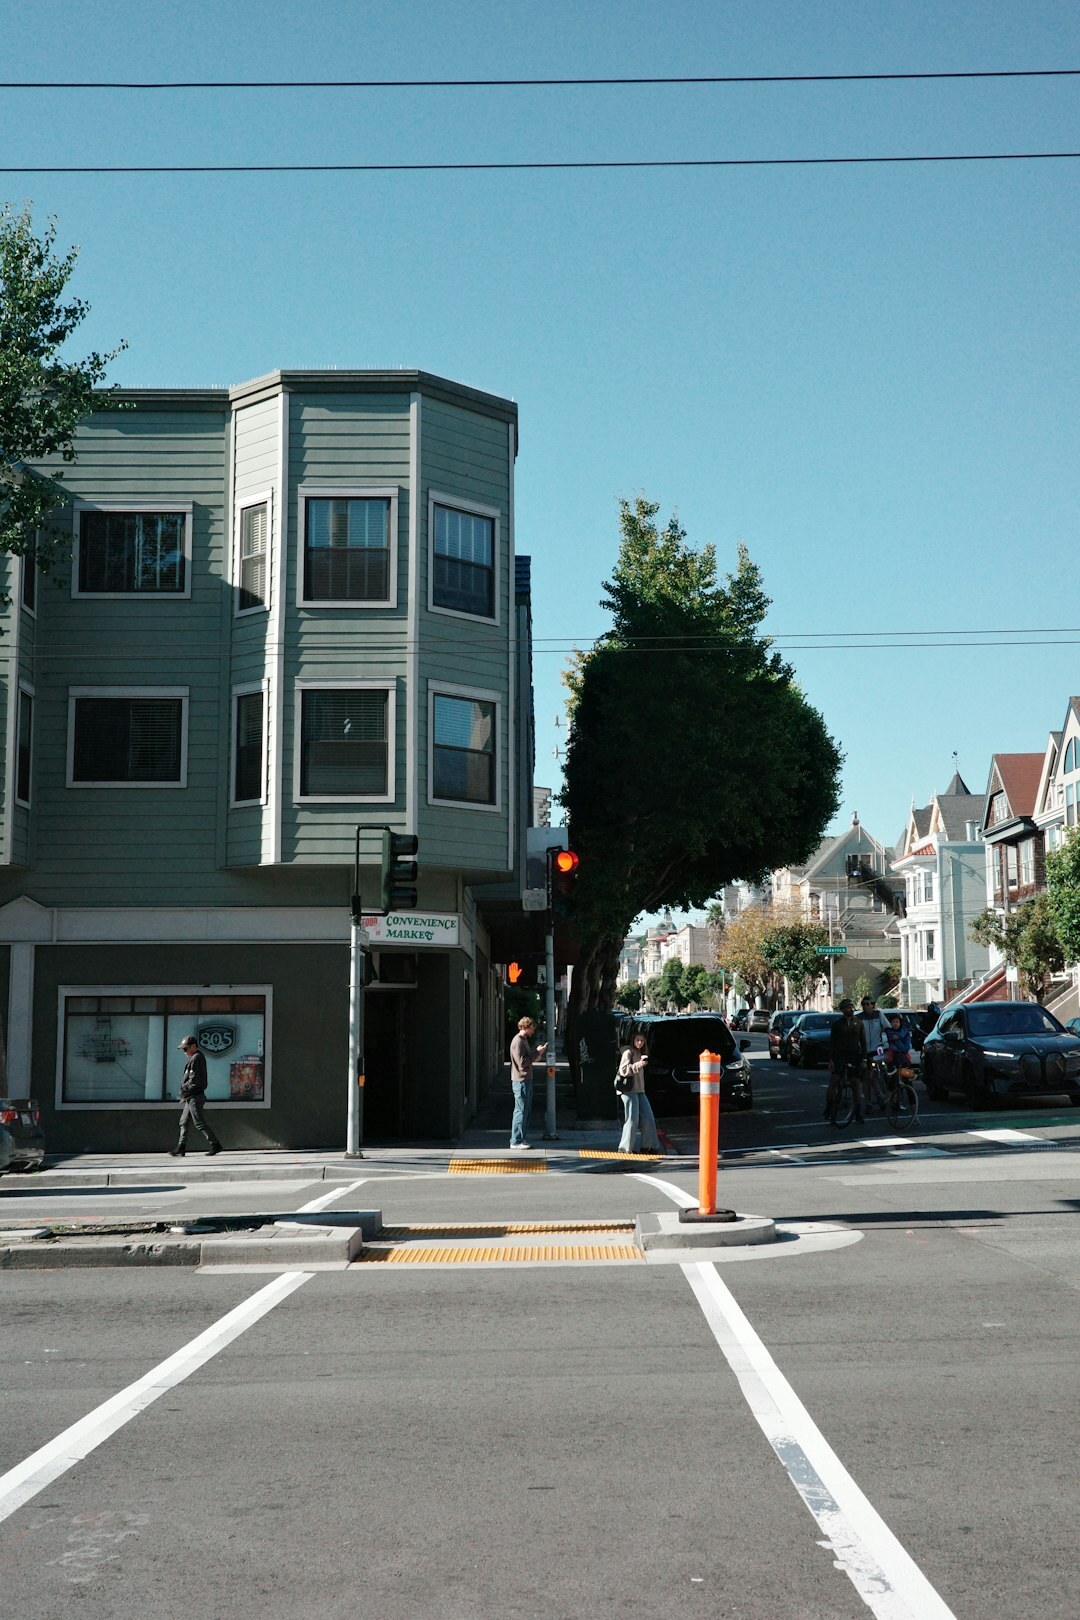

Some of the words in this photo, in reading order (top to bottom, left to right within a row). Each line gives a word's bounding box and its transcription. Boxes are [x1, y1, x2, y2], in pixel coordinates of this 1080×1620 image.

[386, 916, 456, 930] CONVENIENCE
[386, 929, 434, 941] MARKET
[200, 1032, 232, 1046] 805
